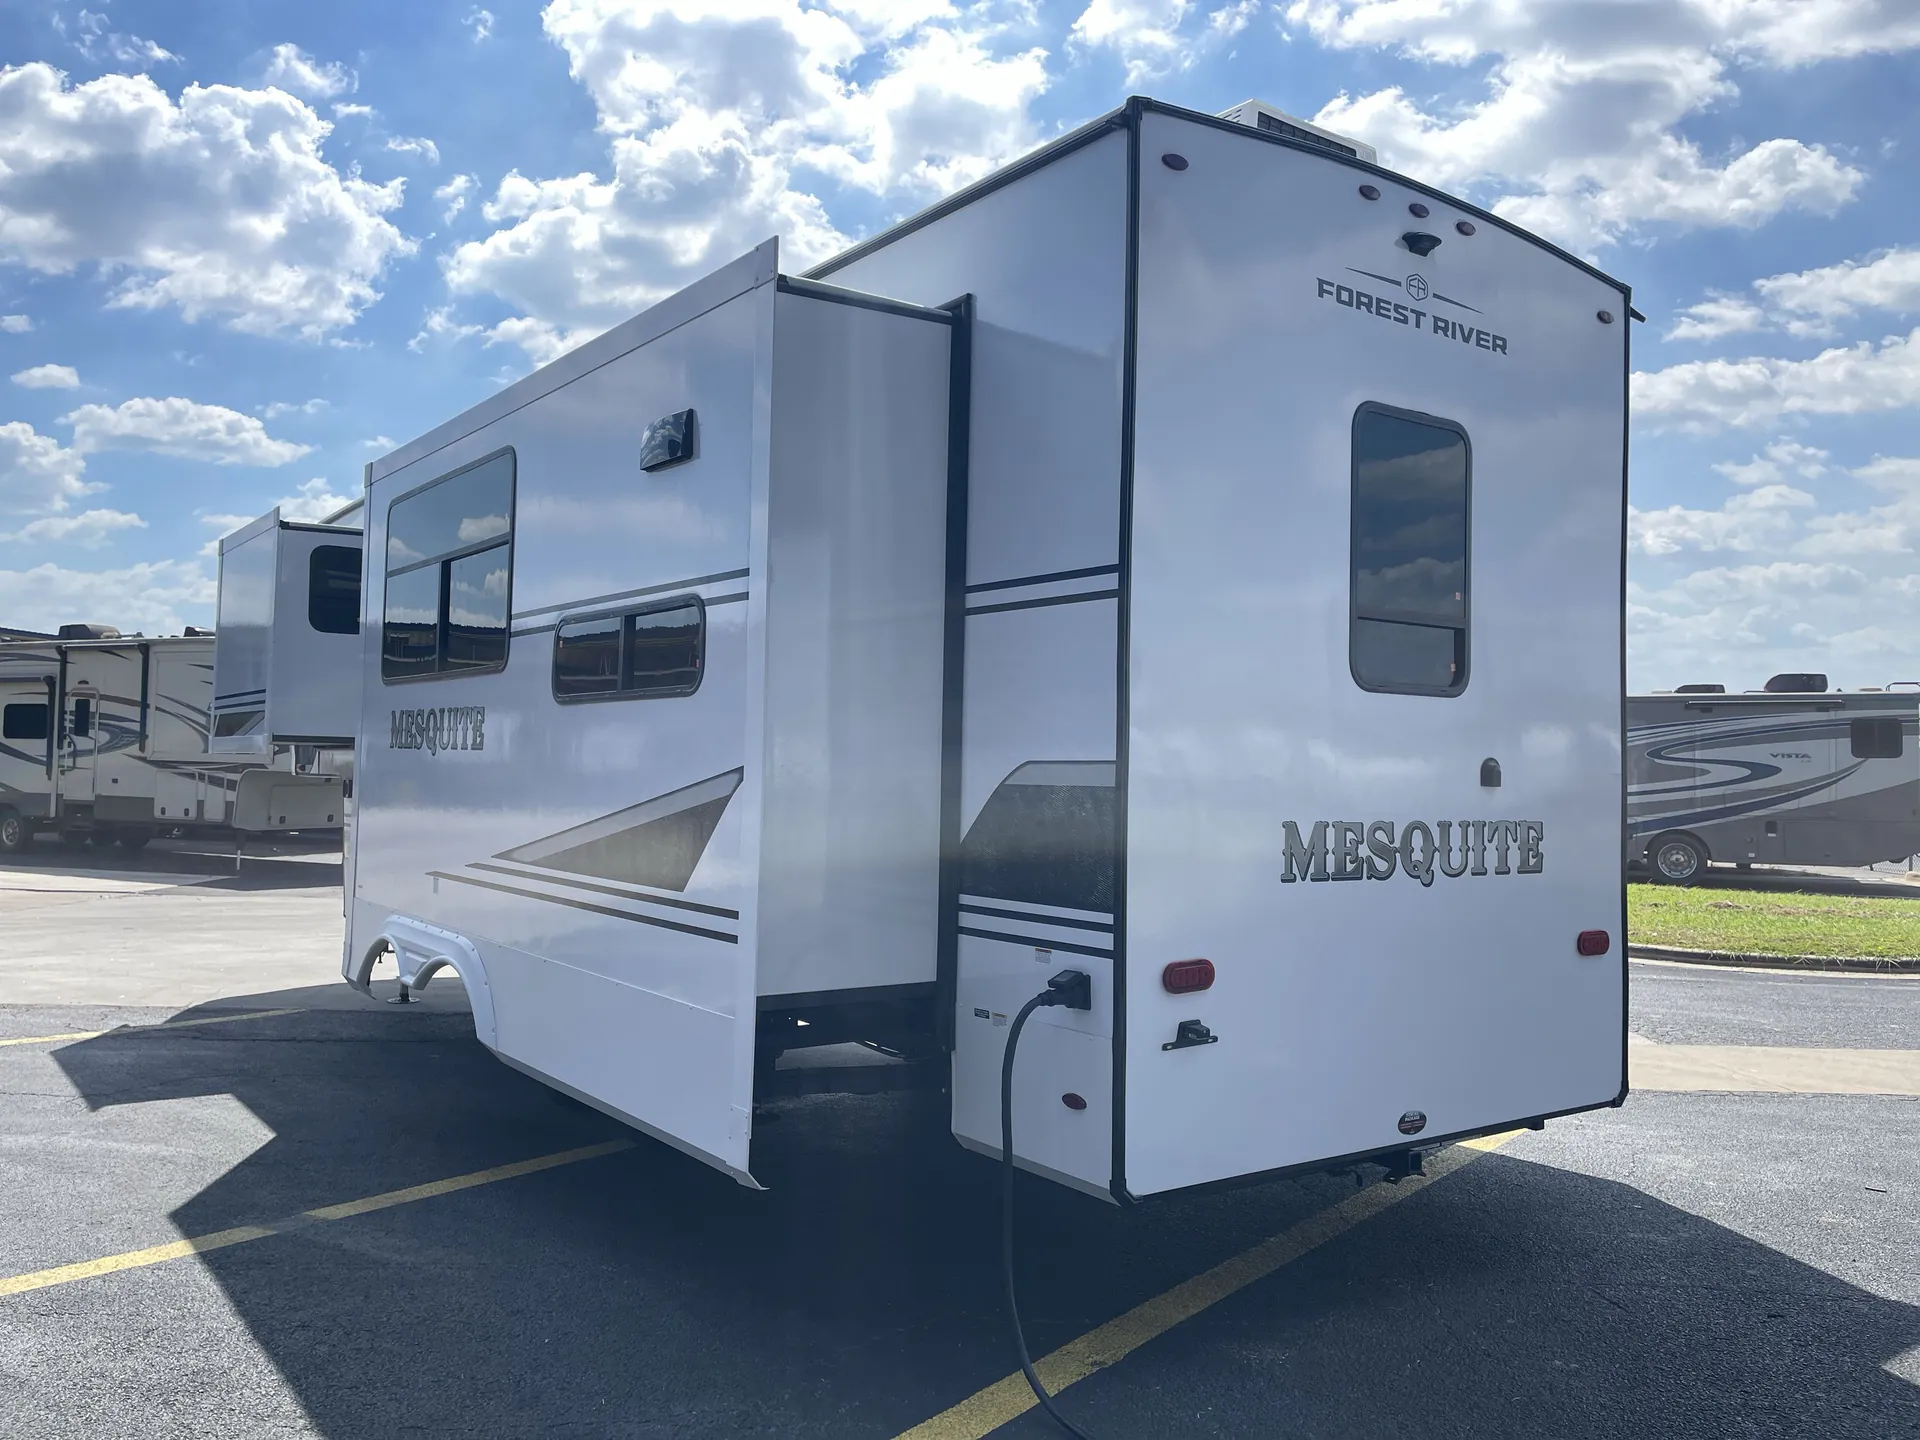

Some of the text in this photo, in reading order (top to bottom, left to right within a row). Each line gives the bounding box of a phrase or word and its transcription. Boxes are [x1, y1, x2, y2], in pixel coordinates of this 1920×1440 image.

[1316, 277, 1508, 356] FOREST RIVER
[389, 706, 486, 757] MESQUITE
[1280, 820, 1545, 888] MESQUITE
